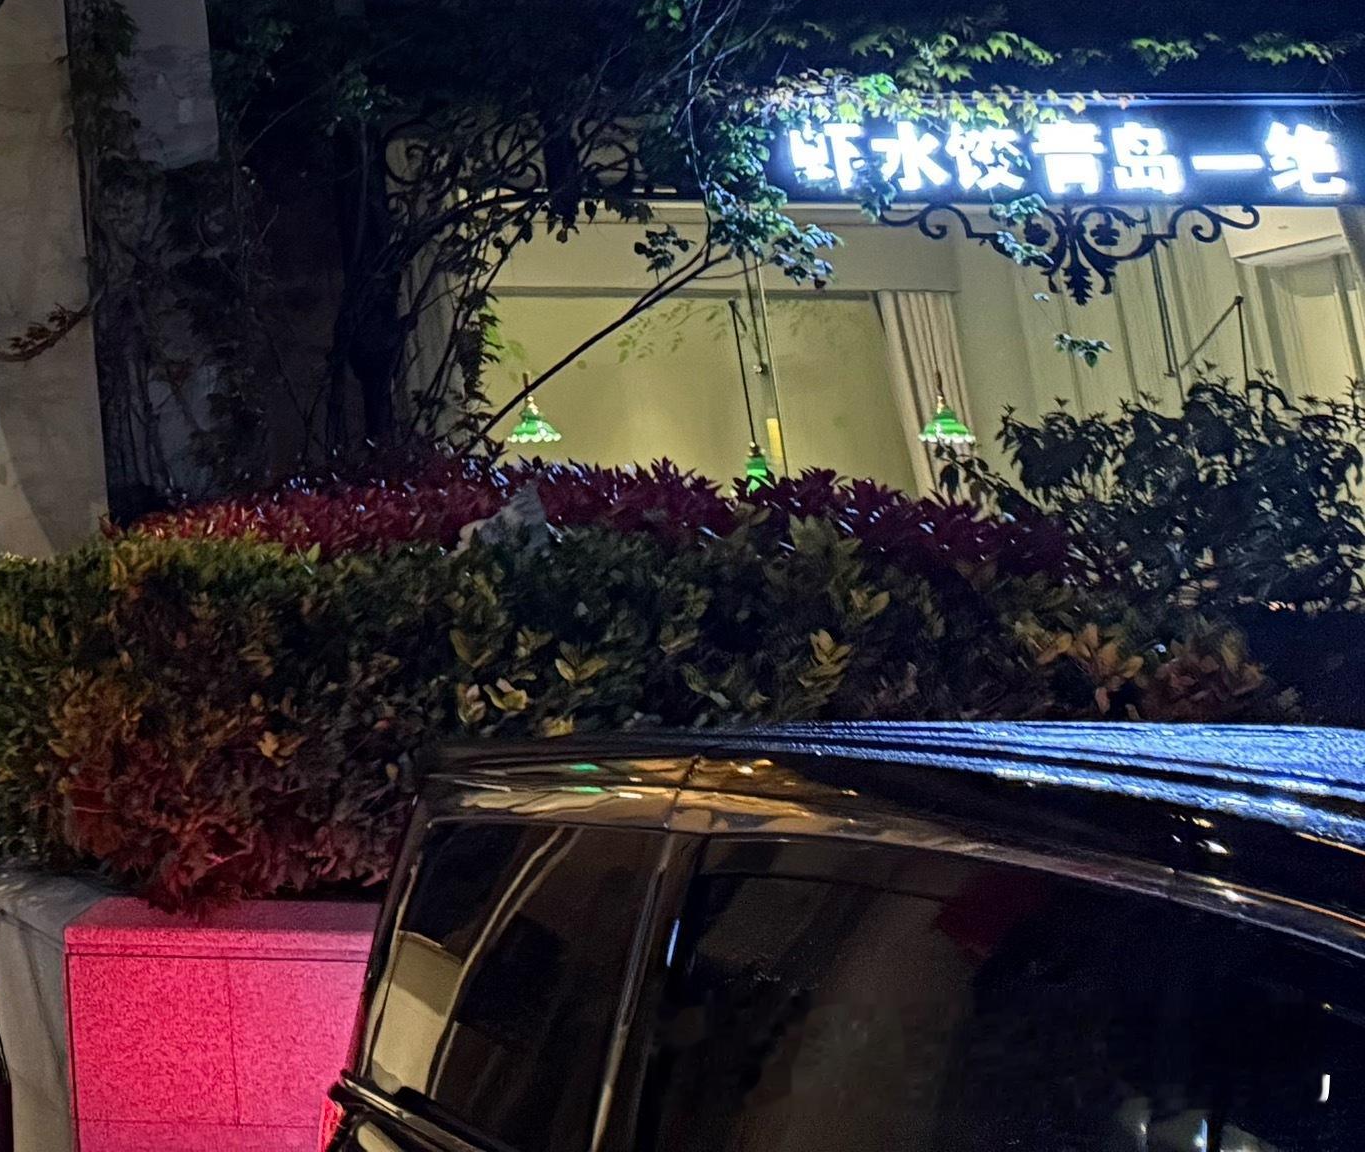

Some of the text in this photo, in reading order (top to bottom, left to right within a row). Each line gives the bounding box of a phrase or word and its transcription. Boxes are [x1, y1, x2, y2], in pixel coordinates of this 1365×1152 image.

[788, 119, 1347, 196] 虾水饺青岛一绝
